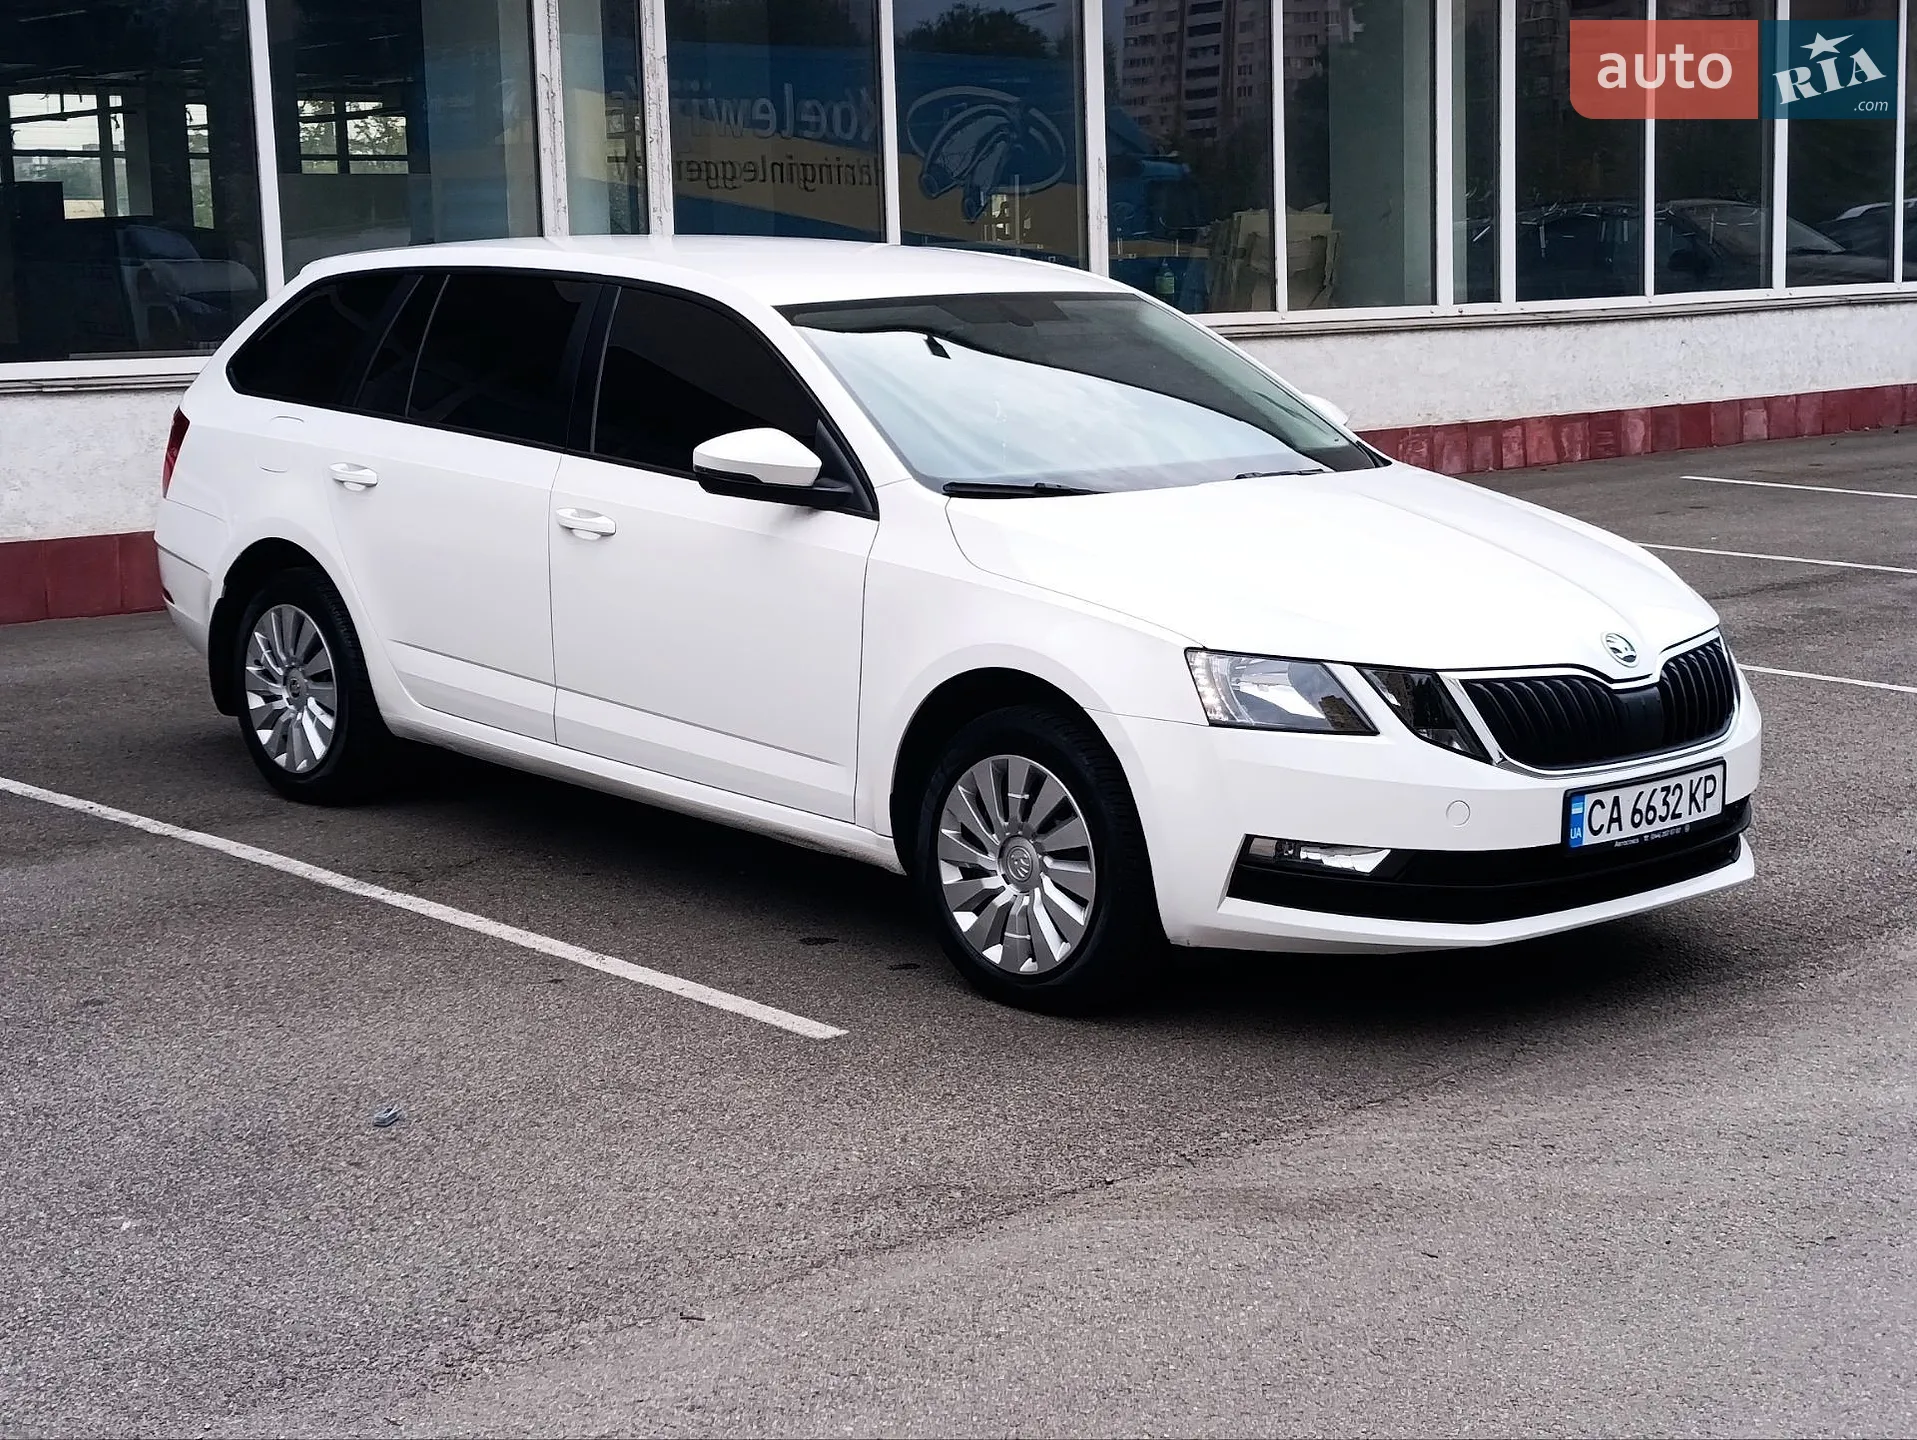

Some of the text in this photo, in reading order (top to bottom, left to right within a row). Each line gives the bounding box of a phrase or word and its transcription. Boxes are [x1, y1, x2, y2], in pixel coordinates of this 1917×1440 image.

[1588, 774, 1716, 836] CA 6632 KP
[1570, 827, 1582, 839] UA
